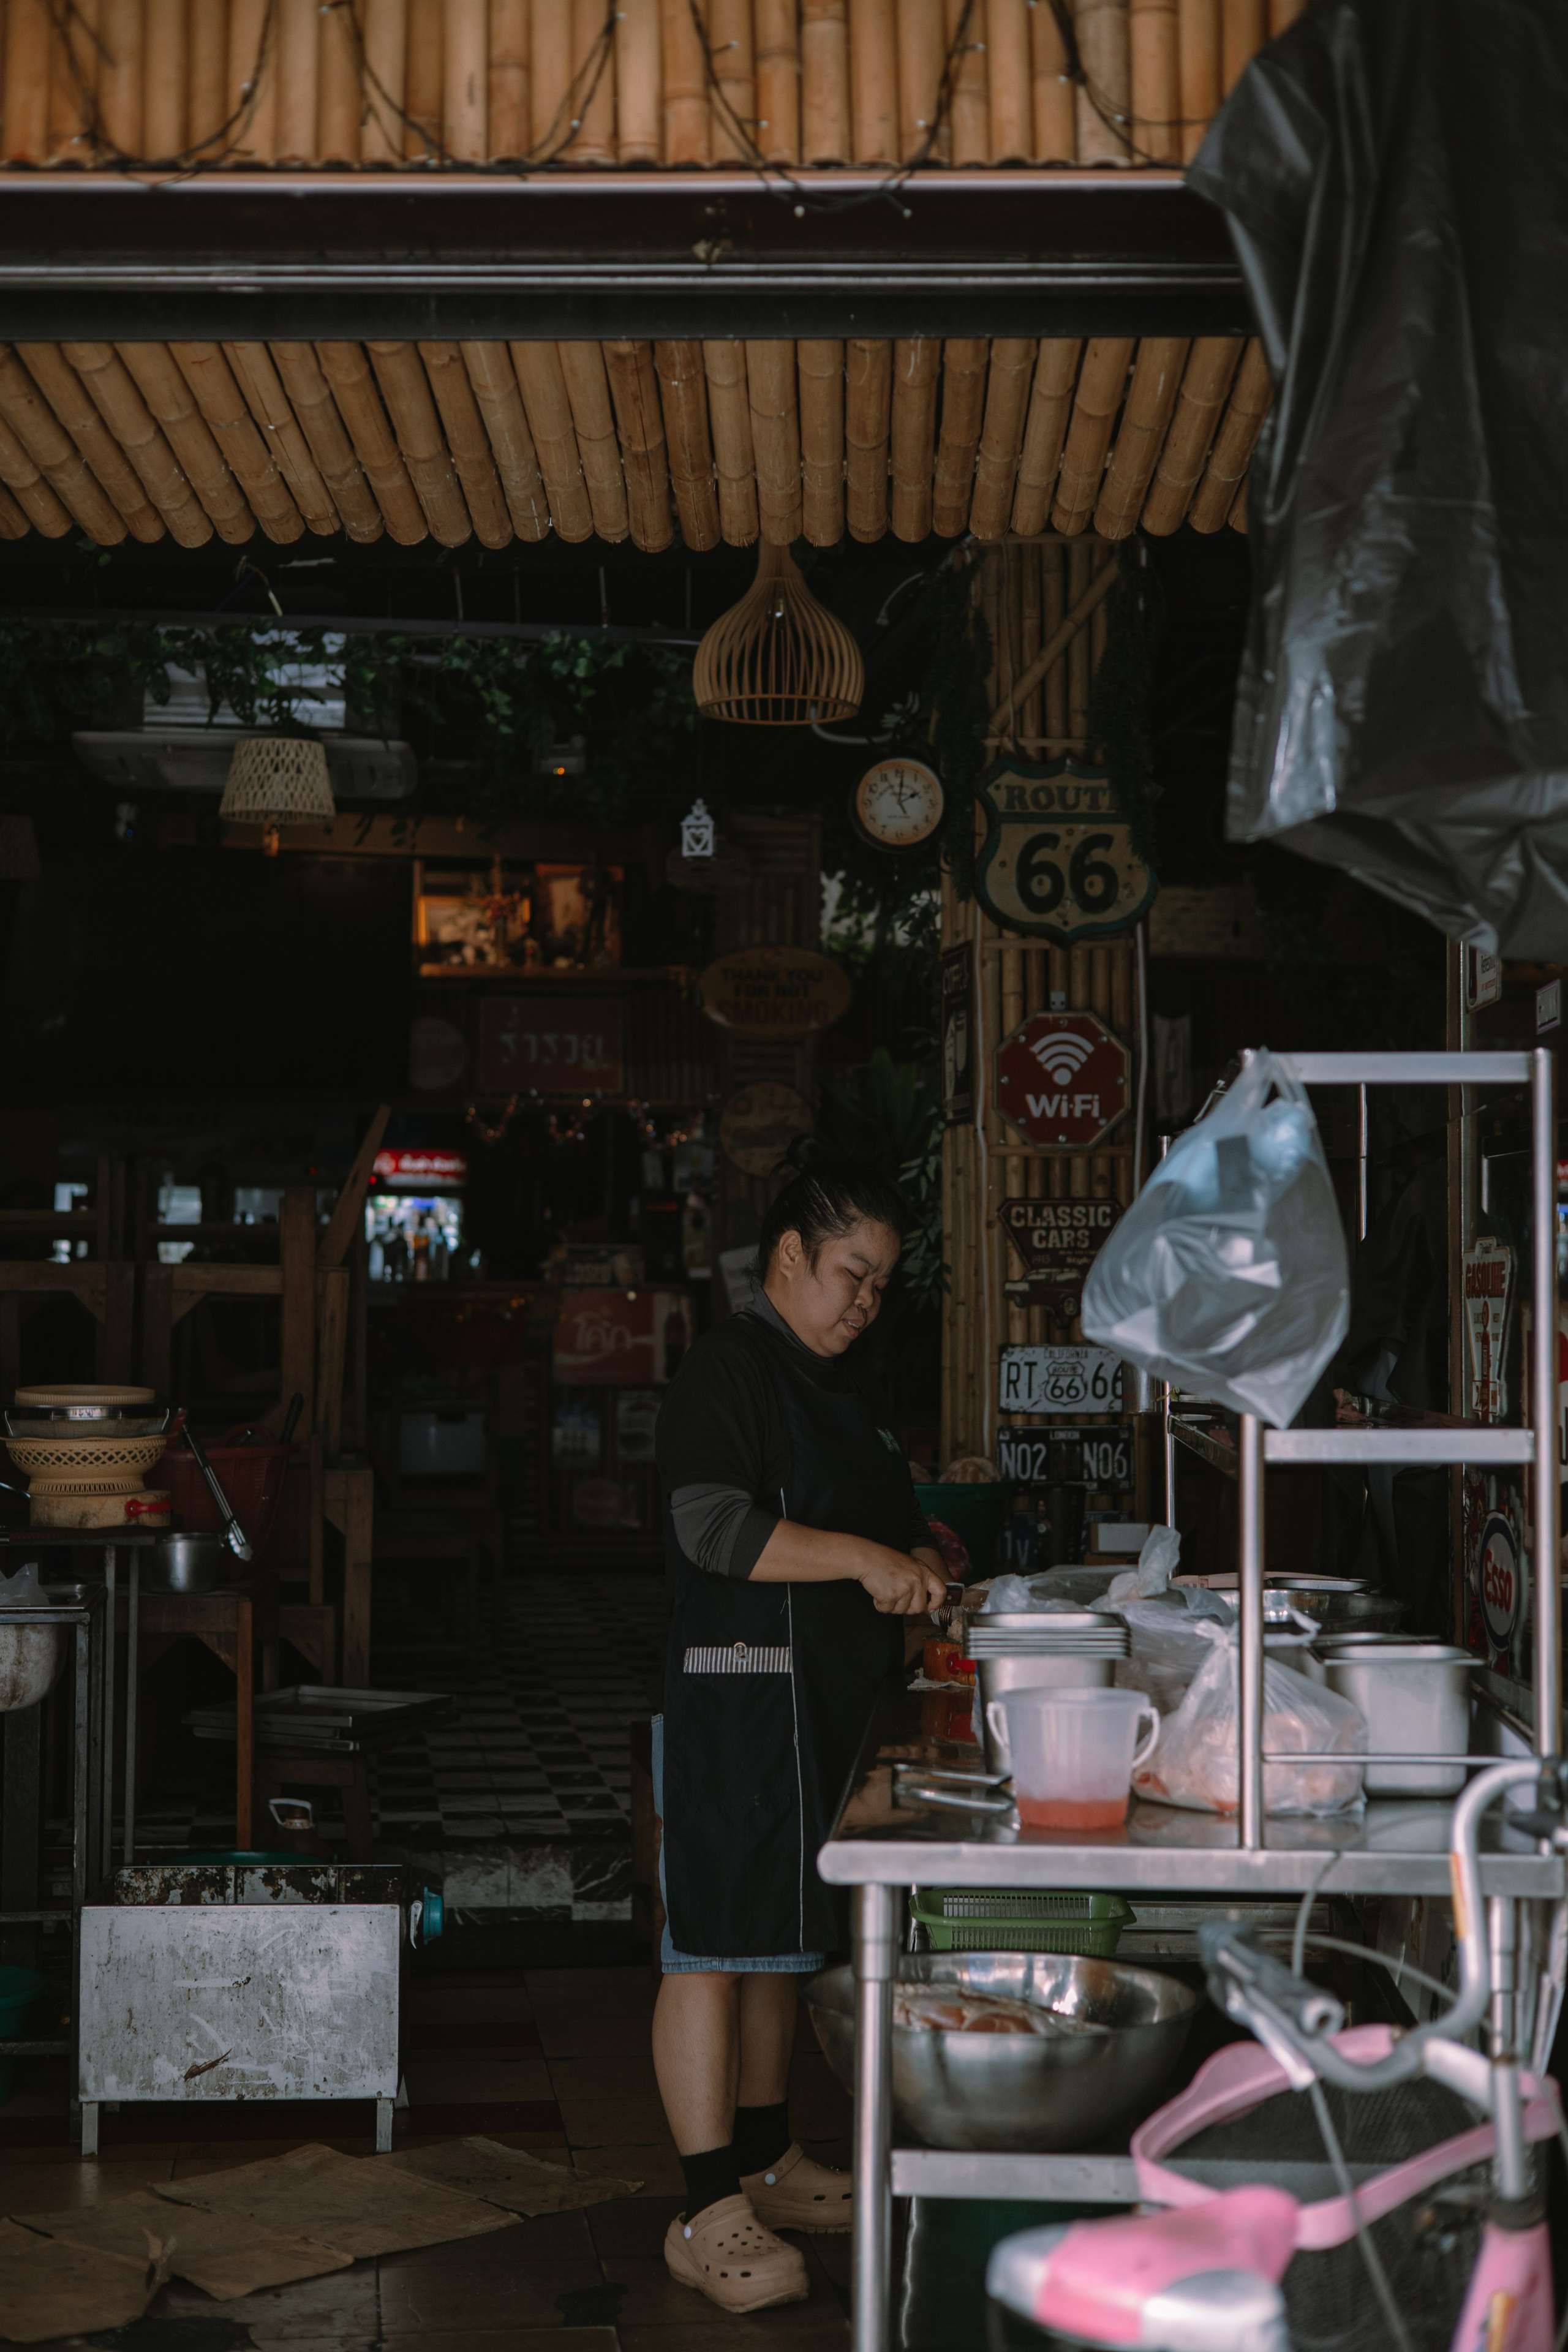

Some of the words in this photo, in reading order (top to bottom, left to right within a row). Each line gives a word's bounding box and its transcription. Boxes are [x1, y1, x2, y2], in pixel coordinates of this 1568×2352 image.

[1005, 785, 1118, 810] ROUT
[1016, 832, 1118, 914] 66
[722, 968, 778, 981] THANK
[785, 968, 823, 982] YOU
[734, 983, 769, 997] FOR
[775, 983, 810, 997] NOT
[717, 1000, 829, 1023] SMOKING
[1011, 1205, 1112, 1227] CLASSIC
[1032, 1229, 1090, 1249] CARS
[1465, 1262, 1506, 1298] GASOLINE
[1044, 1348, 1088, 1359] CALIFORNIA
[1006, 1361, 1037, 1398] RT
[1050, 1378, 1080, 1398] 66
[1049, 1430, 1080, 1440] LONDON
[1483, 1548, 1512, 1613] Esso
